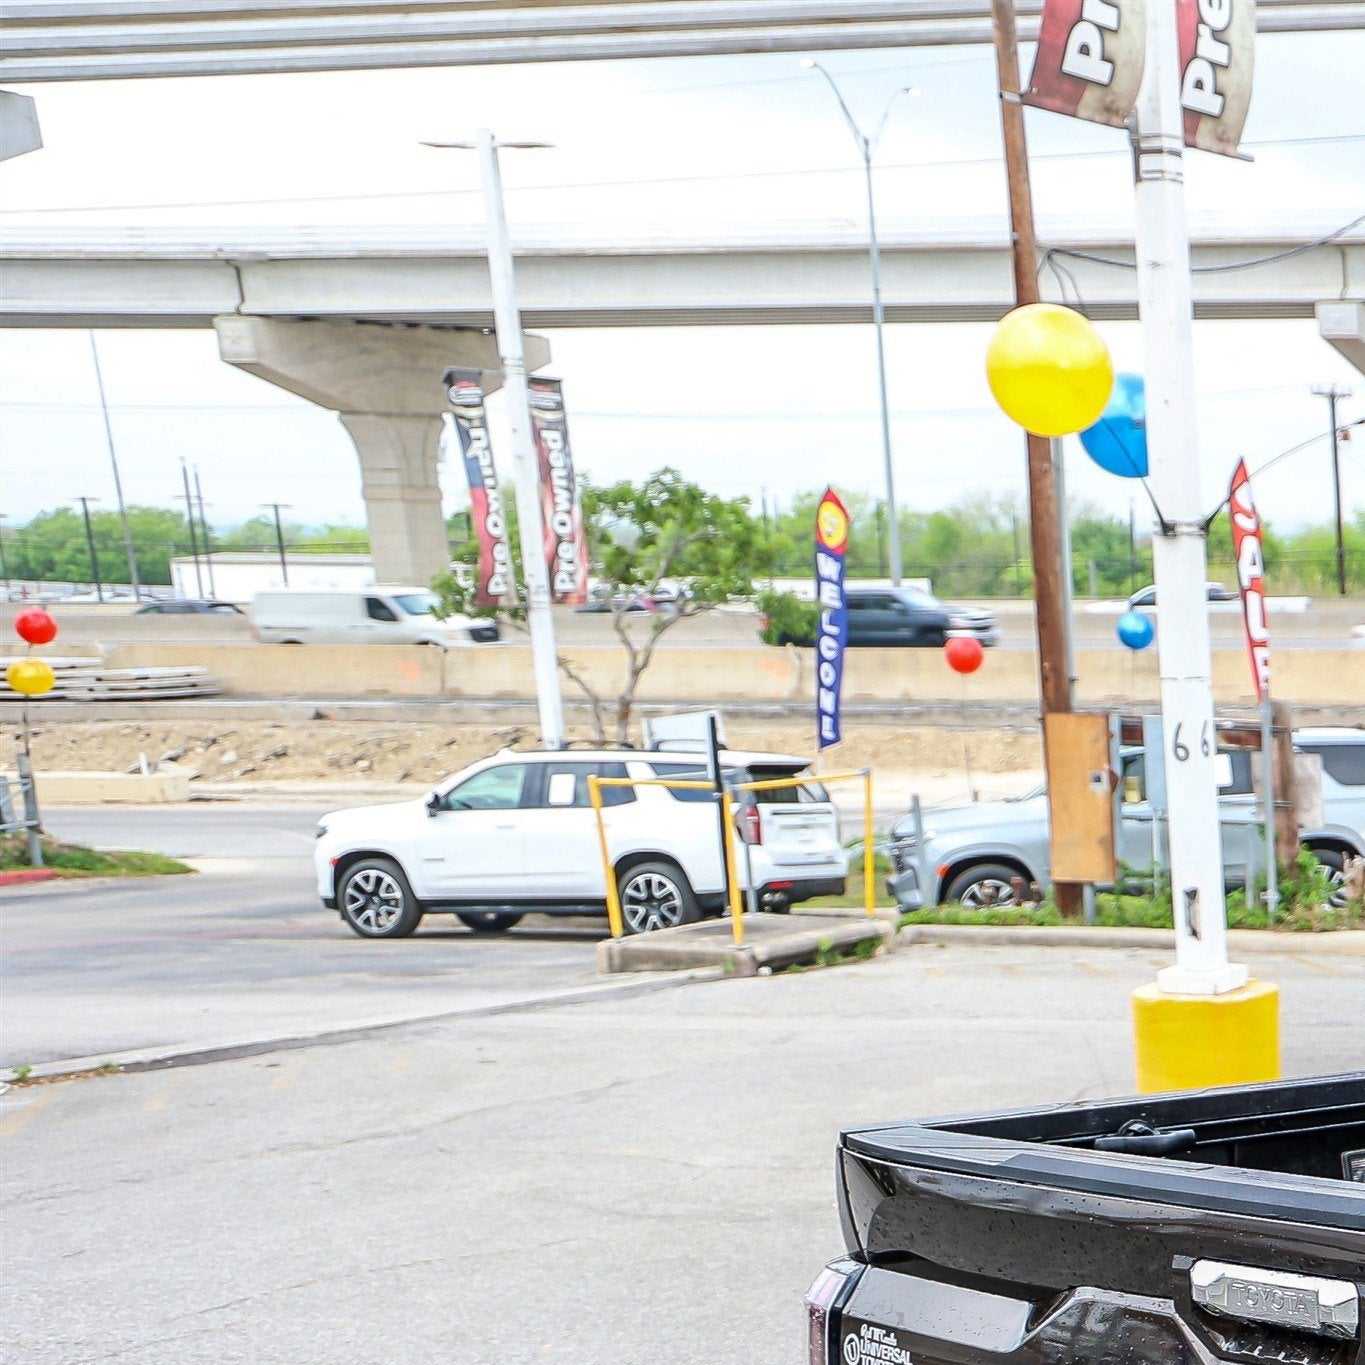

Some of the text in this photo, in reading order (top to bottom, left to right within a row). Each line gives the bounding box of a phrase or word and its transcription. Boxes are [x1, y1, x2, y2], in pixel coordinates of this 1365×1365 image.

[1061, 0, 1121, 86] Pr
[539, 428, 573, 538] Owned
[553, 541, 577, 593] Pre
[816, 552, 844, 741] WELCOME
[1231, 1280, 1311, 1316] TOYOTA
